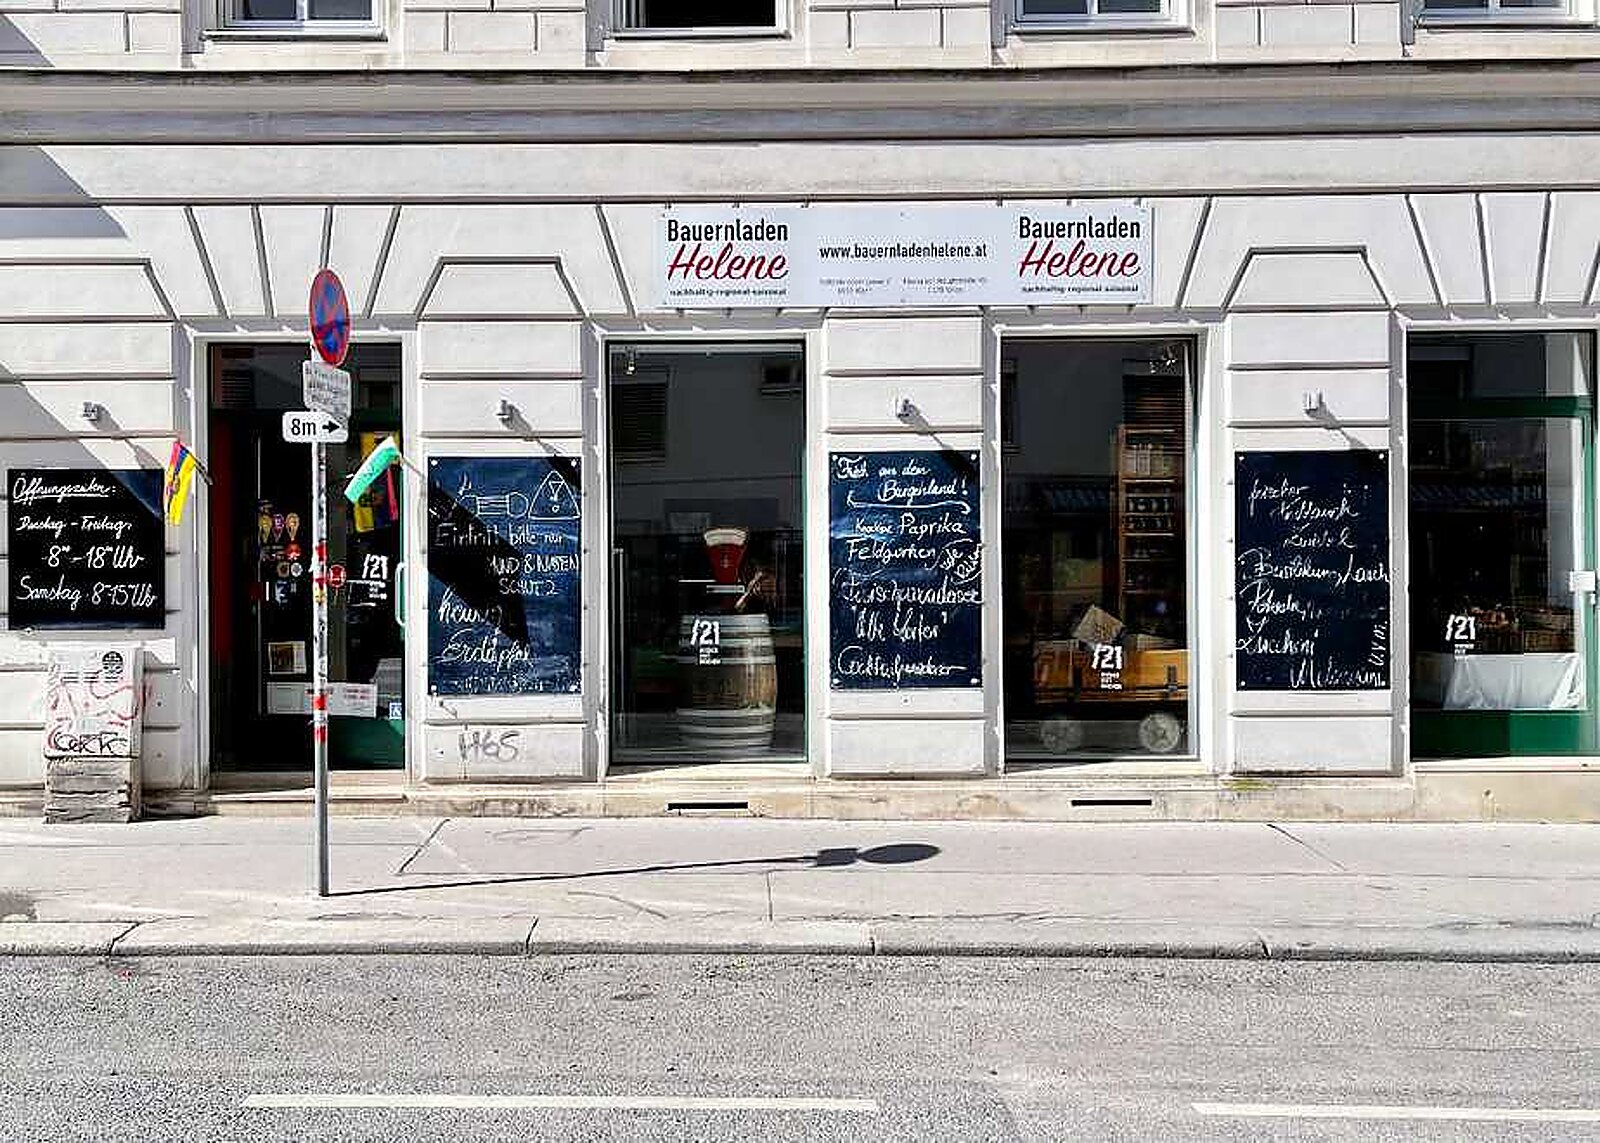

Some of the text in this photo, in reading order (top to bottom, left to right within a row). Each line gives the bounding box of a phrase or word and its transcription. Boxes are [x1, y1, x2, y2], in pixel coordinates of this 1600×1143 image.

[667, 218, 789, 242] Bauernladen
[1018, 215, 1141, 239] Bauernladen
[667, 242, 790, 281] Helene
[818, 243, 988, 259] www.bauernladenhelene.at
[1018, 239, 1142, 278] Helene
[290, 418, 317, 436] 8m
[898, 512, 968, 541] Paprika
[16, 573, 83, 611] Samstag
